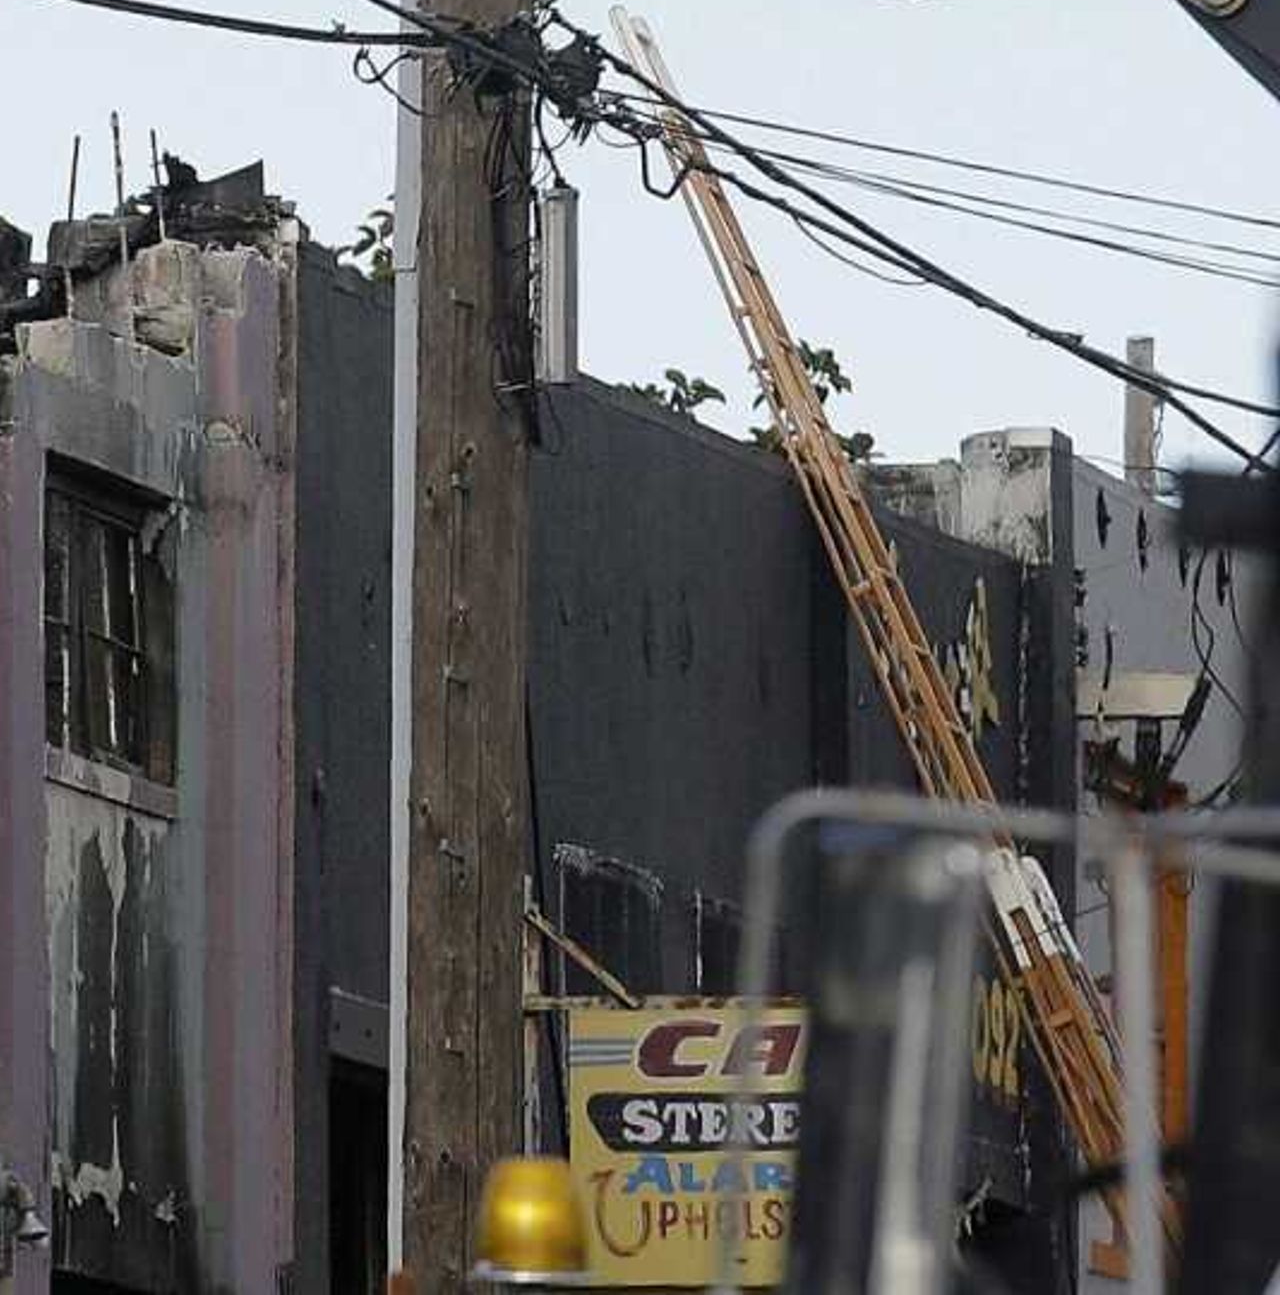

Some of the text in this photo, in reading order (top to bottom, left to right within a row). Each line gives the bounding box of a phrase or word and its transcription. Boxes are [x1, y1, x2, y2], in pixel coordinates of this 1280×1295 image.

[638, 1020, 802, 1078] CA
[622, 1100, 801, 1145] STERE
[624, 1154, 796, 1194] ALAR
[588, 1167, 790, 1258] UPHOLS
